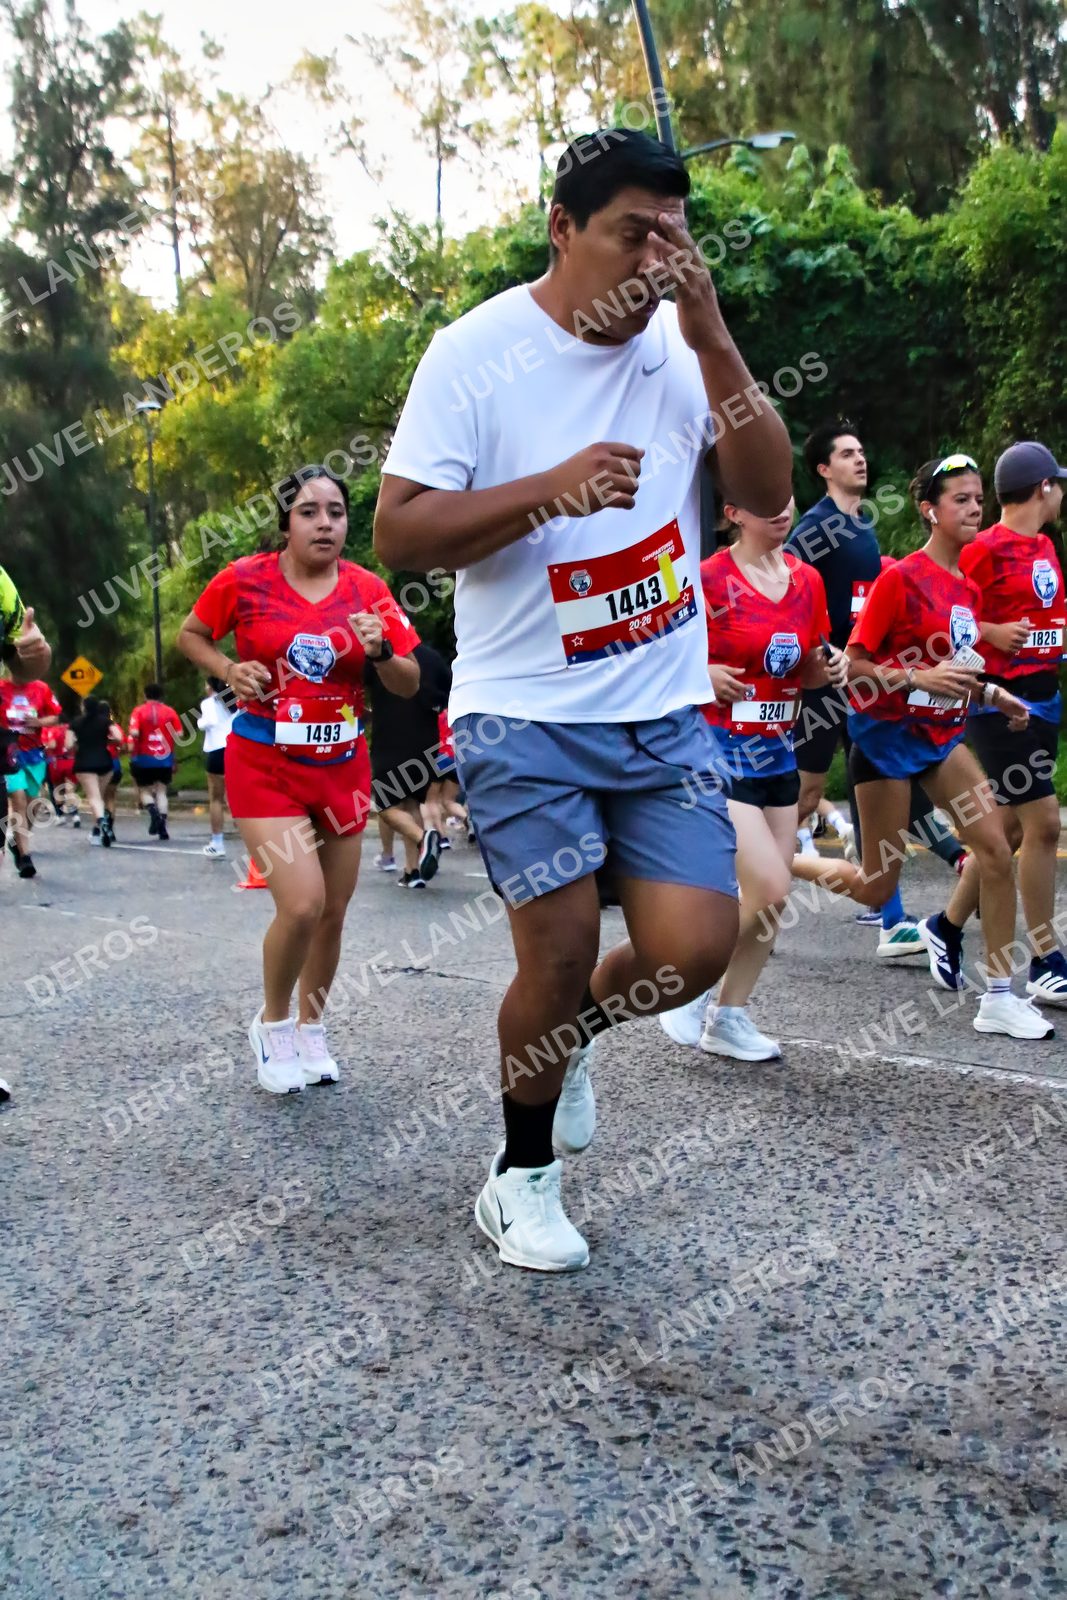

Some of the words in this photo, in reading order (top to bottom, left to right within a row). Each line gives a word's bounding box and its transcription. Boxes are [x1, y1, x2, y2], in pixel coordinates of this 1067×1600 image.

[606, 576, 662, 621] 1443
[678, 606, 689, 619] 5K
[629, 614, 652, 631] 20-26
[1032, 630, 1057, 646] 1826
[760, 703, 786, 720] 3241
[306, 724, 341, 742] 1493
